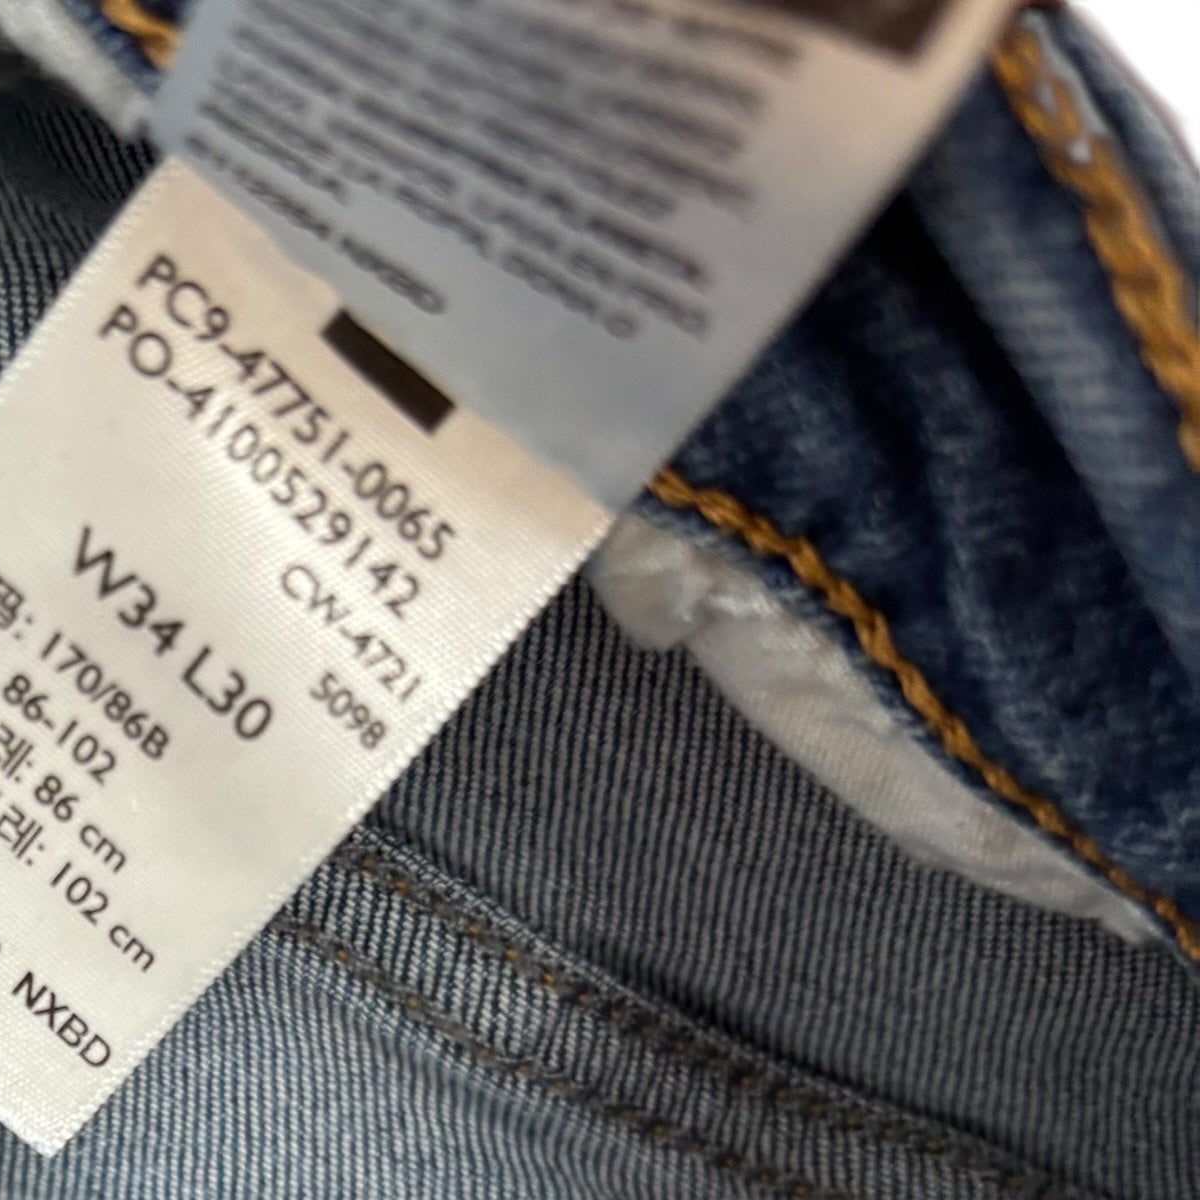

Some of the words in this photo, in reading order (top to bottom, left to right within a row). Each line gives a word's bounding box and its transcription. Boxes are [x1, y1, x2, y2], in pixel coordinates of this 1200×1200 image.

[99, 304, 420, 618] PO-4100529142
[136, 254, 456, 561] PC9-47751-0065
[73, 526, 185, 656] W34
[181, 646, 274, 740] L30
[281, 564, 421, 702] CW-4721
[2, 674, 116, 786] 86-102
[40, 631, 170, 760] 170/86B
[309, 671, 387, 750] 5098
[33, 775, 80, 823] 86
[79, 823, 128, 874] cm
[50, 861, 110, 926] 102
[108, 923, 156, 973] cm
[11, 970, 112, 1068] NXBD
